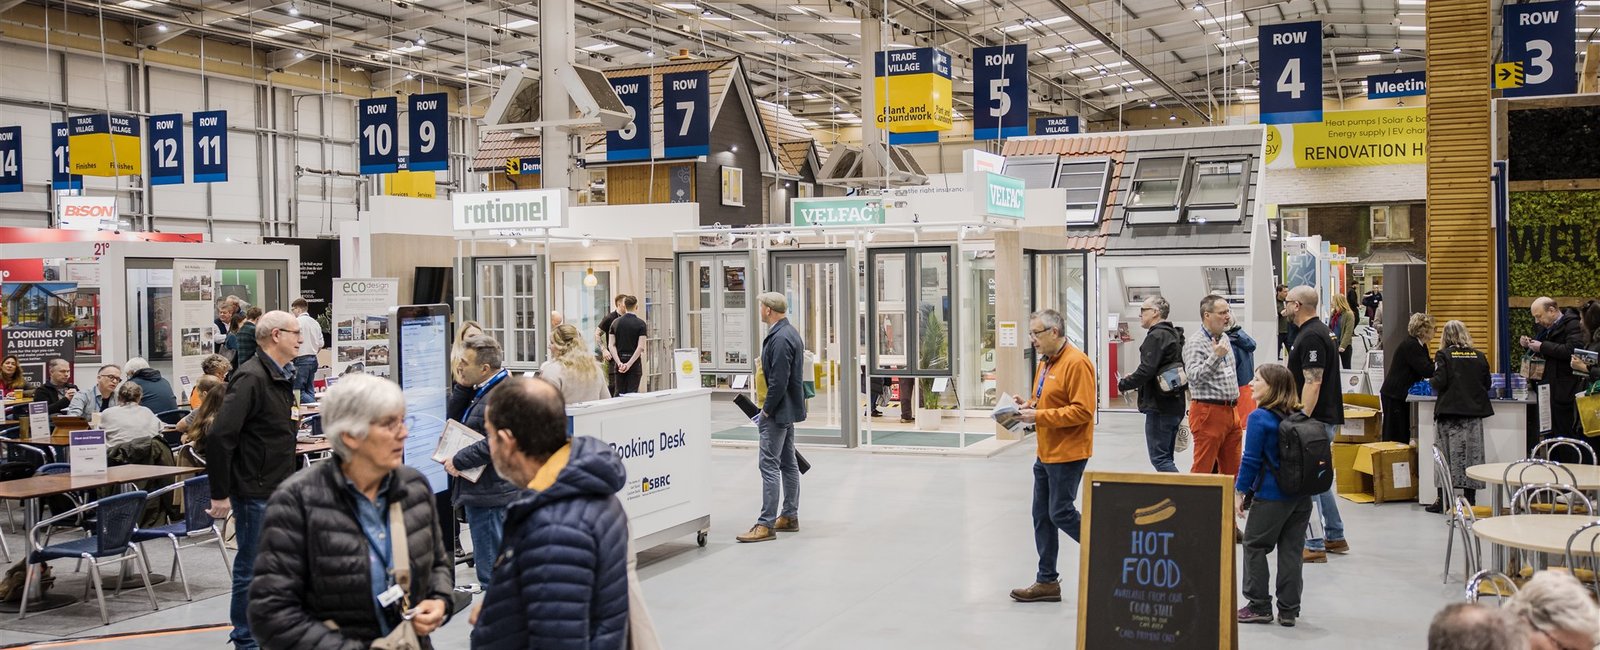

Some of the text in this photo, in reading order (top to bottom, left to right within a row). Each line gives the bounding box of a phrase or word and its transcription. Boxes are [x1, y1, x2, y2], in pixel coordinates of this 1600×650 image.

[1520, 10, 1559, 26] ROW
[1273, 31, 1307, 45] ROW
[891, 52, 917, 62] TRADE
[985, 53, 1014, 66] ROW
[1525, 39, 1553, 84] 3
[888, 62, 920, 73] VILLAGE
[1277, 58, 1305, 99] 4
[615, 83, 639, 95] ROW
[673, 79, 698, 91] ROW
[989, 78, 1011, 117] 5
[367, 104, 387, 115] ROW
[416, 100, 437, 111] ROW
[909, 104, 926, 113] and
[77, 117, 92, 125] TRADE
[111, 117, 129, 125] TRADE
[199, 117, 218, 127] ROW
[676, 101, 695, 136] 7
[1325, 119, 1345, 127] Heat
[1347, 118, 1376, 127] pumps
[1382, 116, 1404, 124] Solar
[1406, 115, 1413, 123] &
[75, 125, 94, 133] VILLAGE
[156, 120, 174, 130] ROW
[363, 123, 392, 155] 10
[419, 120, 435, 153] 9
[1328, 130, 1356, 139] Energy
[1359, 128, 1386, 138] supply
[154, 138, 178, 168] 12
[198, 135, 221, 165] 11
[1305, 142, 1427, 160] RENOVATION H
[76, 161, 96, 170] Finishes
[1511, 224, 1600, 263] WEL
[343, 282, 389, 293] eco design
[7, 329, 73, 339] LOOKING FOR
[7, 339, 64, 348] A BUILDER?
[660, 428, 686, 452] Desk
[1131, 530, 1174, 555] HOT
[1122, 558, 1180, 588] FOOD
[1153, 603, 1174, 617] STALL
